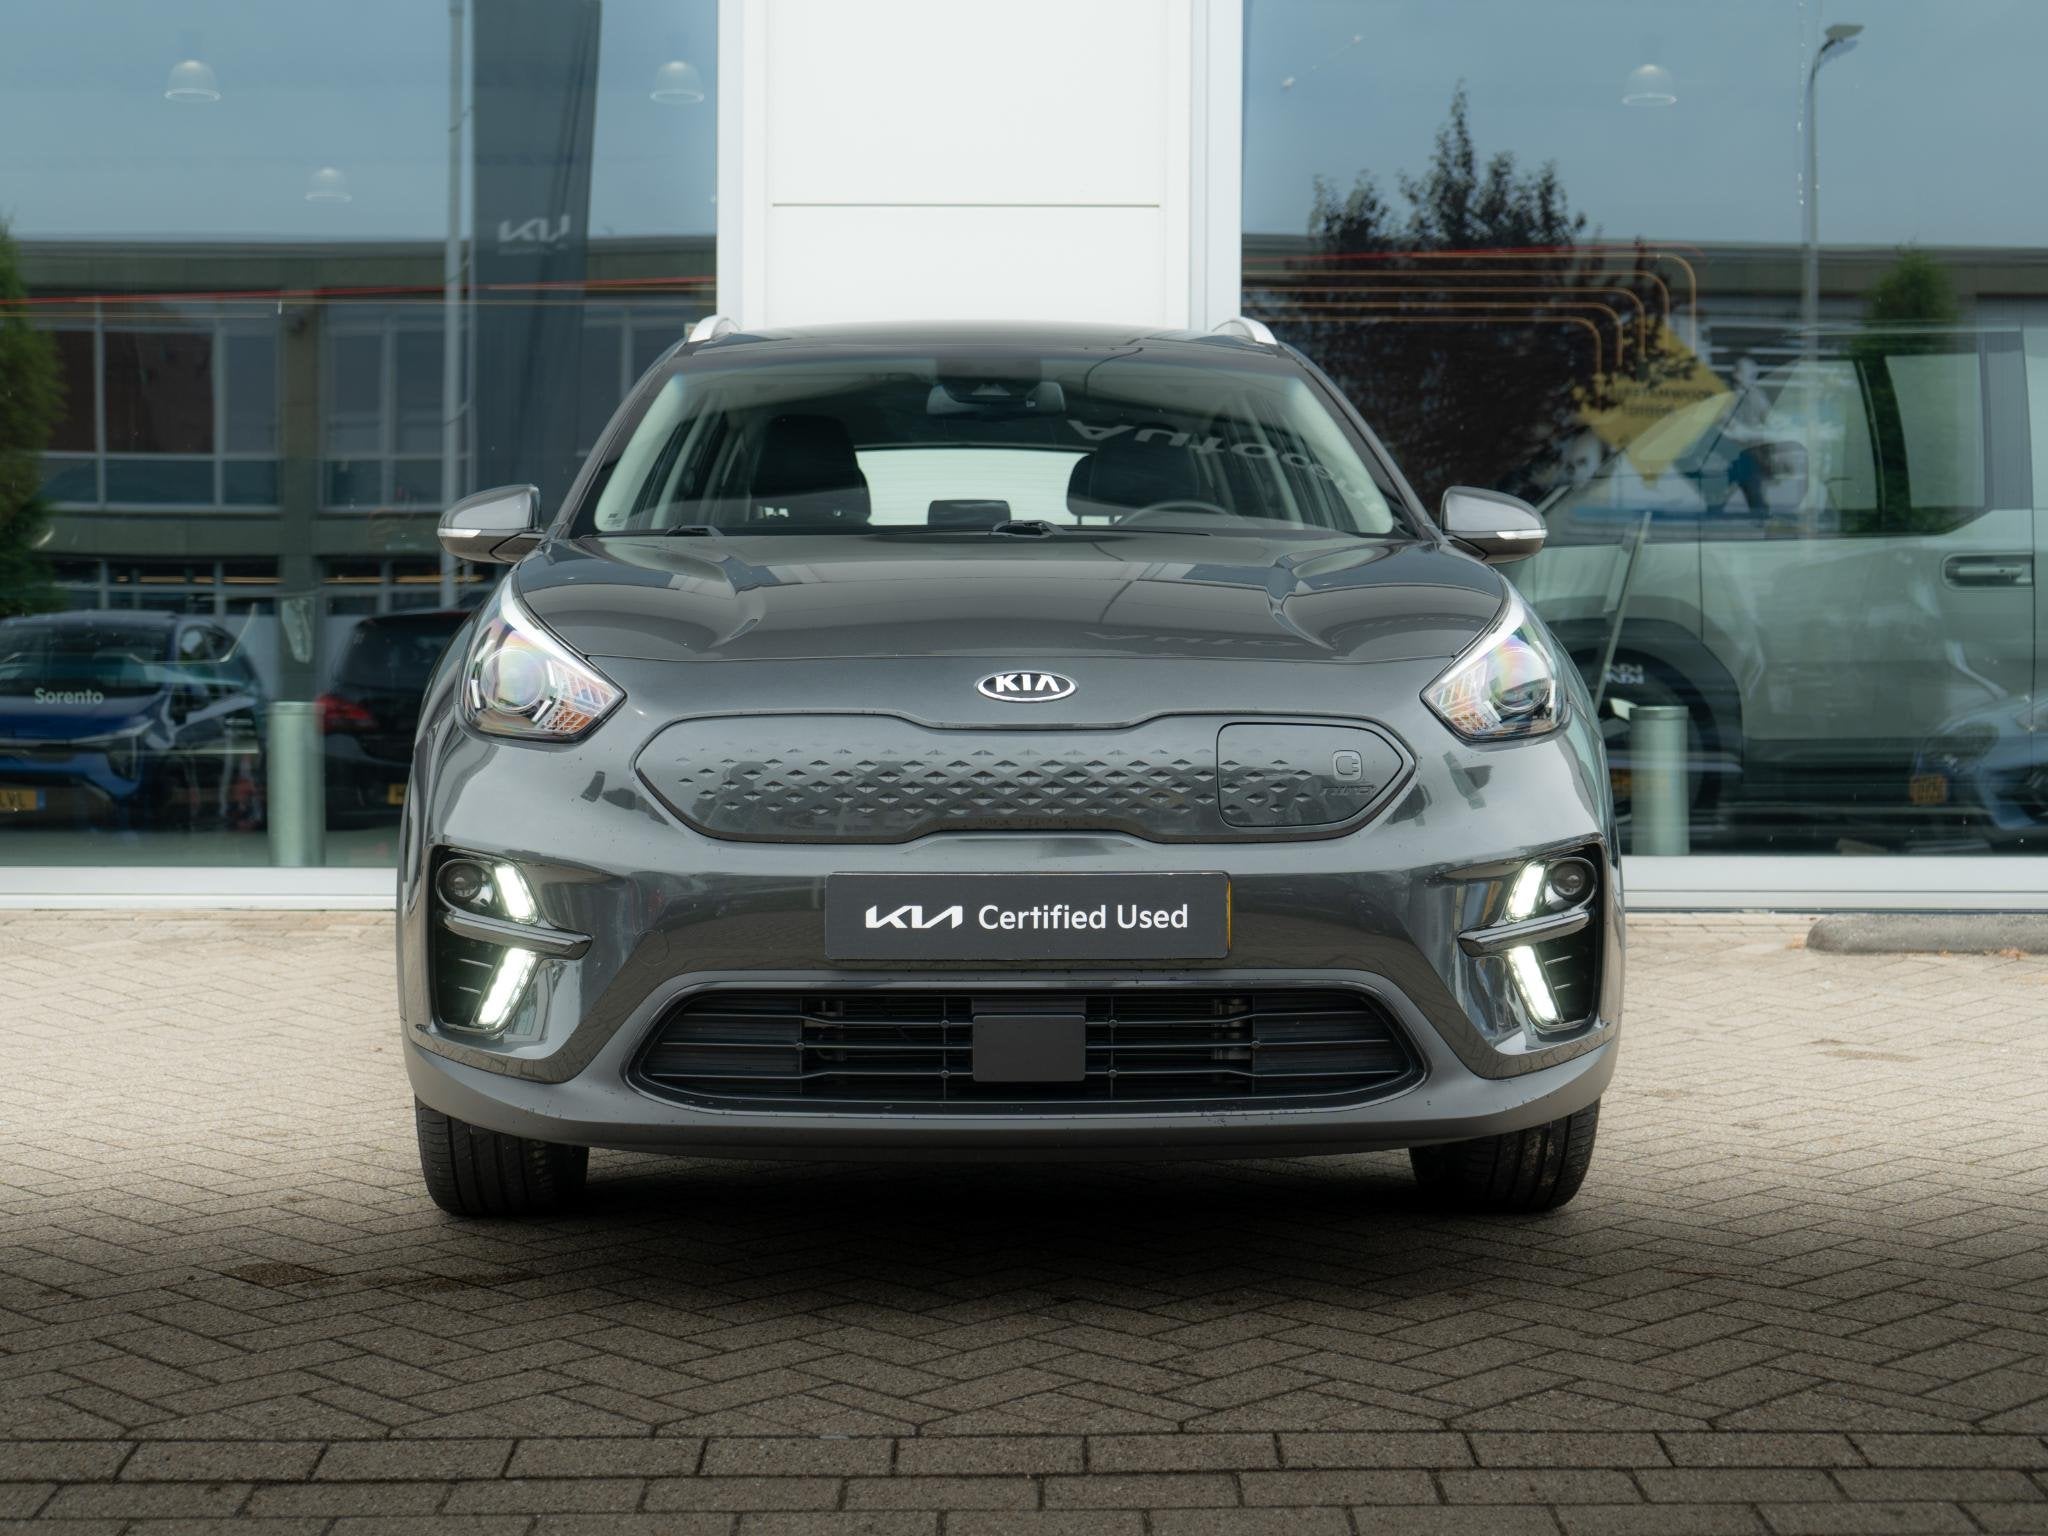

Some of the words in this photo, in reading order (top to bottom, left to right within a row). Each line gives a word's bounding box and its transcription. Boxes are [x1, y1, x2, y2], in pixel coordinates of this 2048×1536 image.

[995, 674, 1060, 693] KIA
[34, 687, 104, 705] Sorento
[865, 905, 963, 929] KIA
[978, 904, 1106, 930] Certified
[1116, 904, 1188, 930] Used
